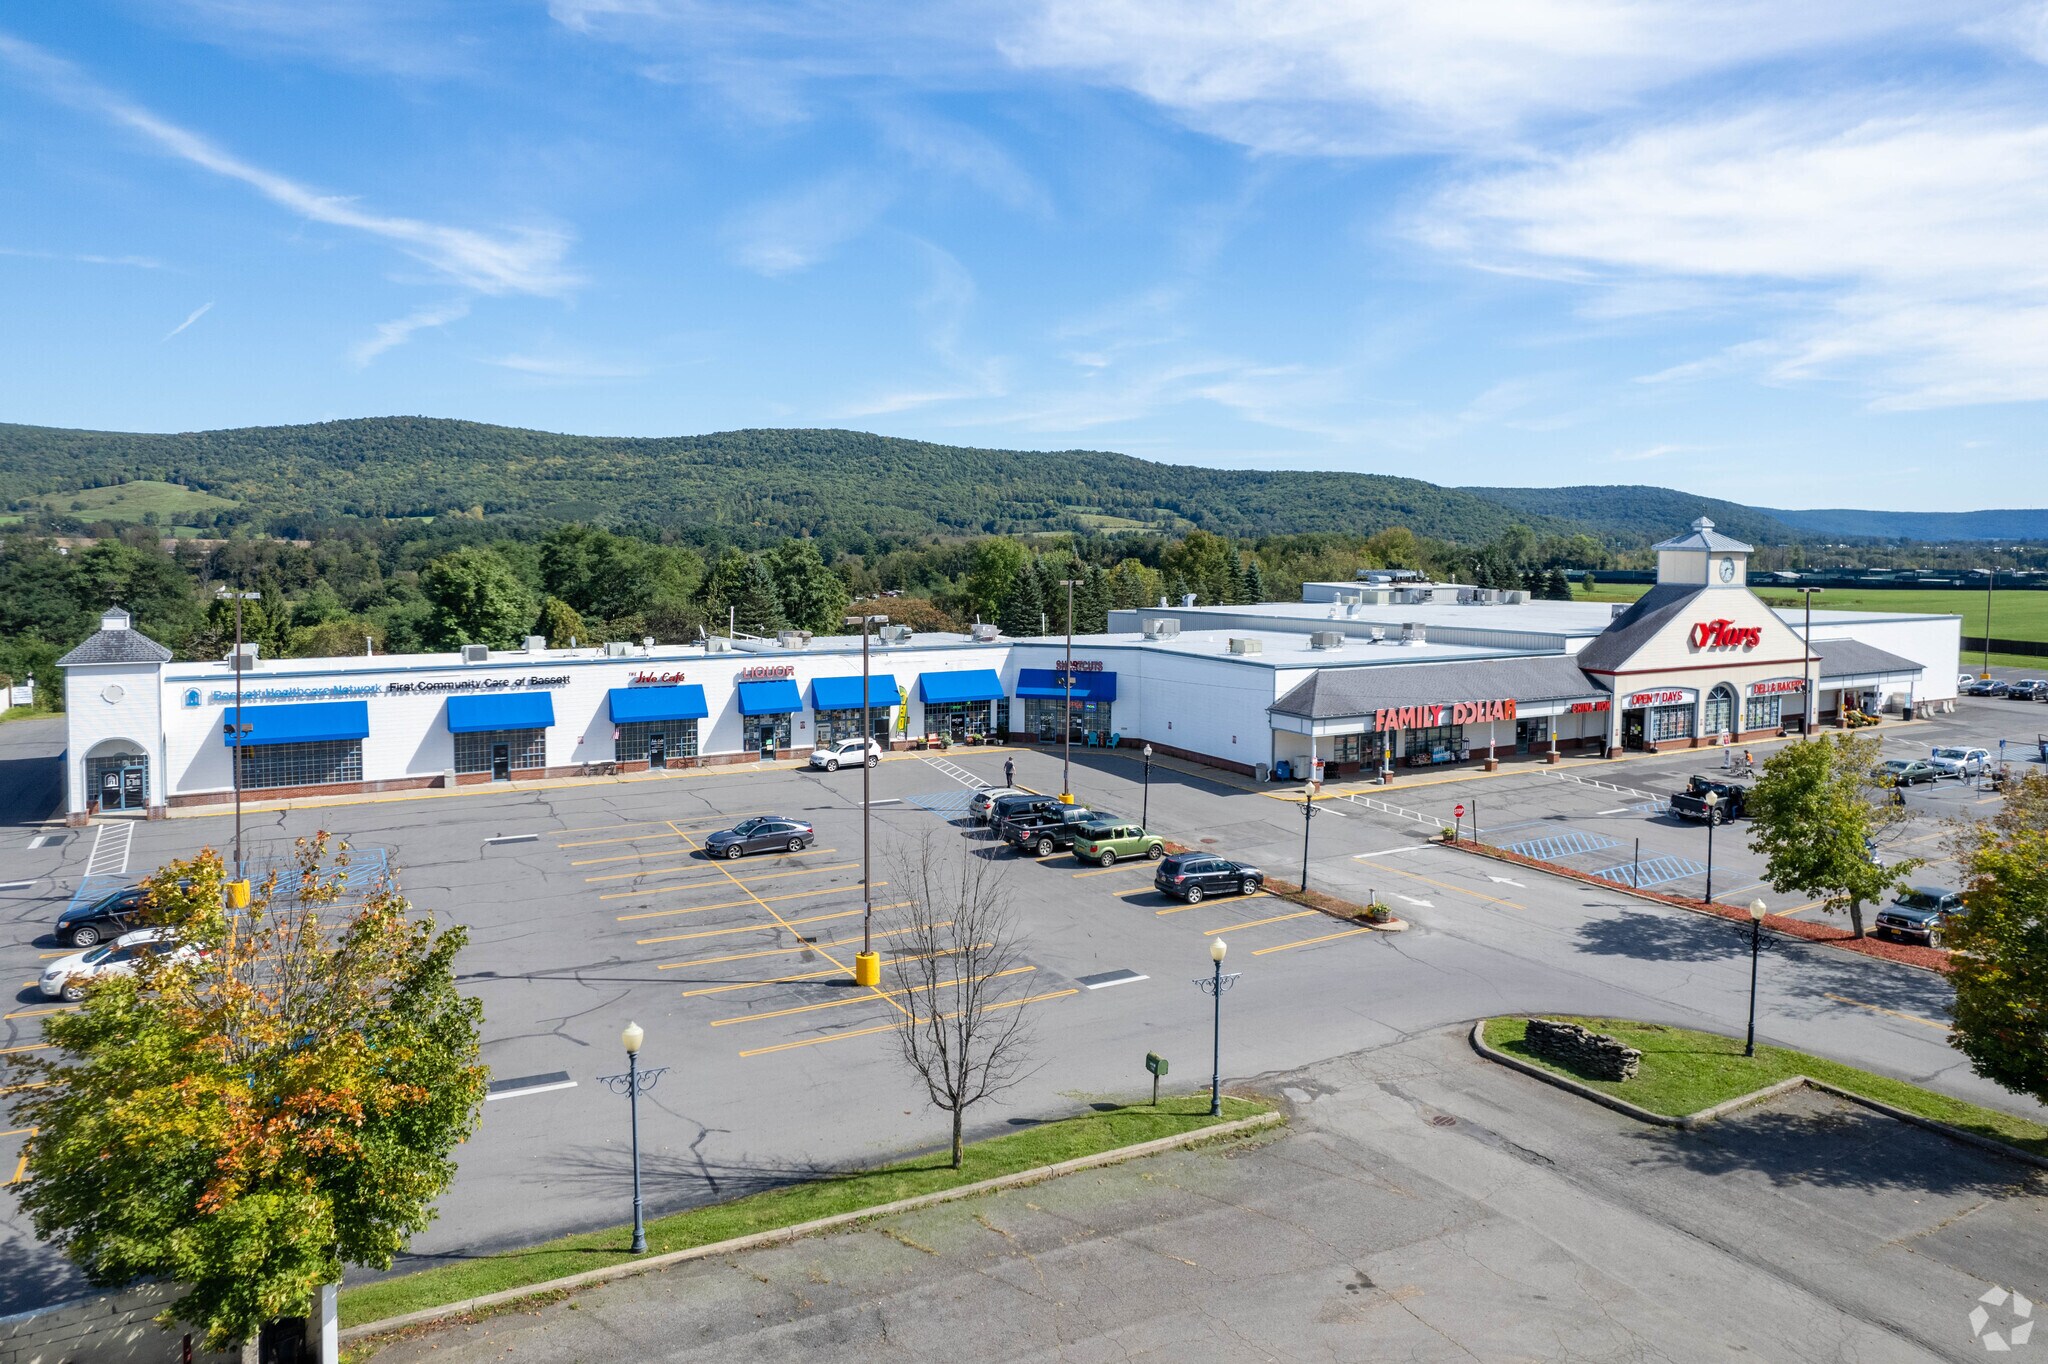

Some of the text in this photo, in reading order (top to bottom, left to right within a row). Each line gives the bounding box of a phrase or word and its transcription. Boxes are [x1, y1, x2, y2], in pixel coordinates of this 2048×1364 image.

[635, 671, 685, 684] Jive Café
[742, 665, 795, 679] LIQUOR
[389, 674, 571, 692] First Community Care of Bassett
[1753, 683, 1770, 694] DELI
[213, 683, 382, 701] Bassett Healthcare Network
[1631, 690, 1683, 705] OPEN 7 DAYS
[1374, 697, 1517, 733] FAMILY DOLLAR
[1571, 702, 1593, 714] CHINA
